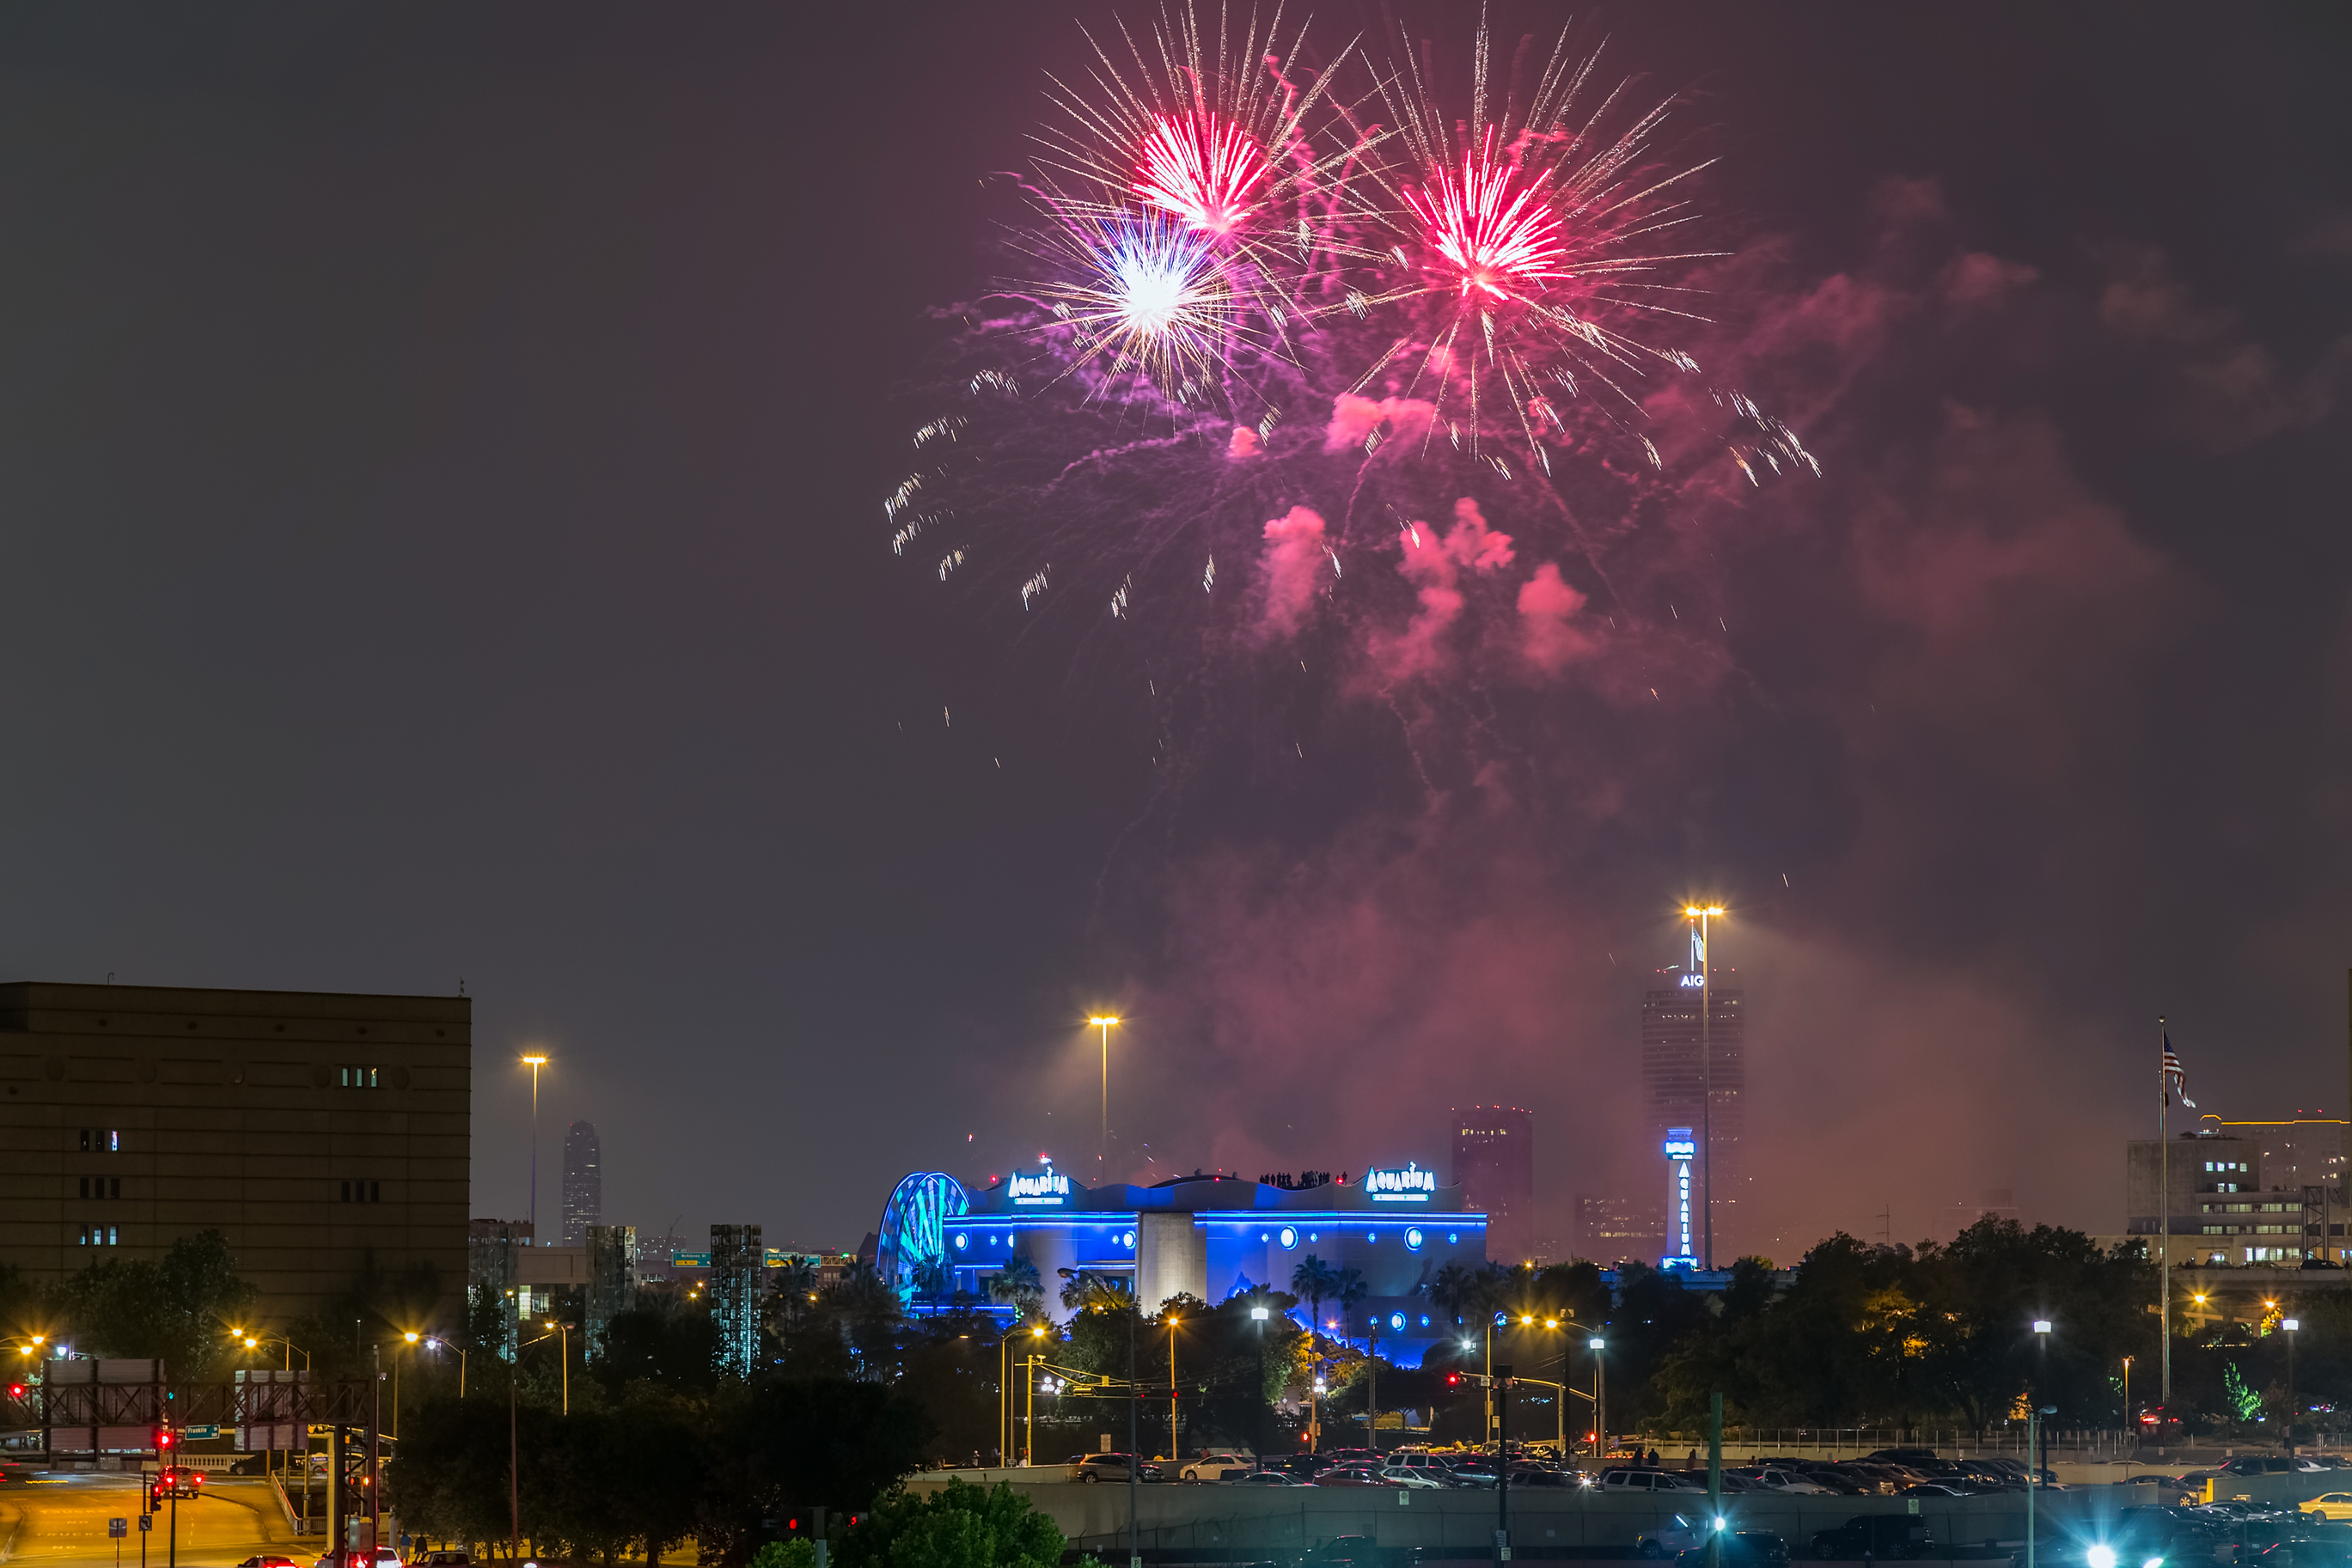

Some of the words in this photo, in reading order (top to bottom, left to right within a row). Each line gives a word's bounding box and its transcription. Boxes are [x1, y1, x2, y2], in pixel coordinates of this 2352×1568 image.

[1680, 974, 1705, 987] AIG
[1008, 1166, 1070, 1198] AQUARIUM
[1365, 1161, 1435, 1193] AQUARIUM
[1677, 1161, 1691, 1256] AQUARIUM
